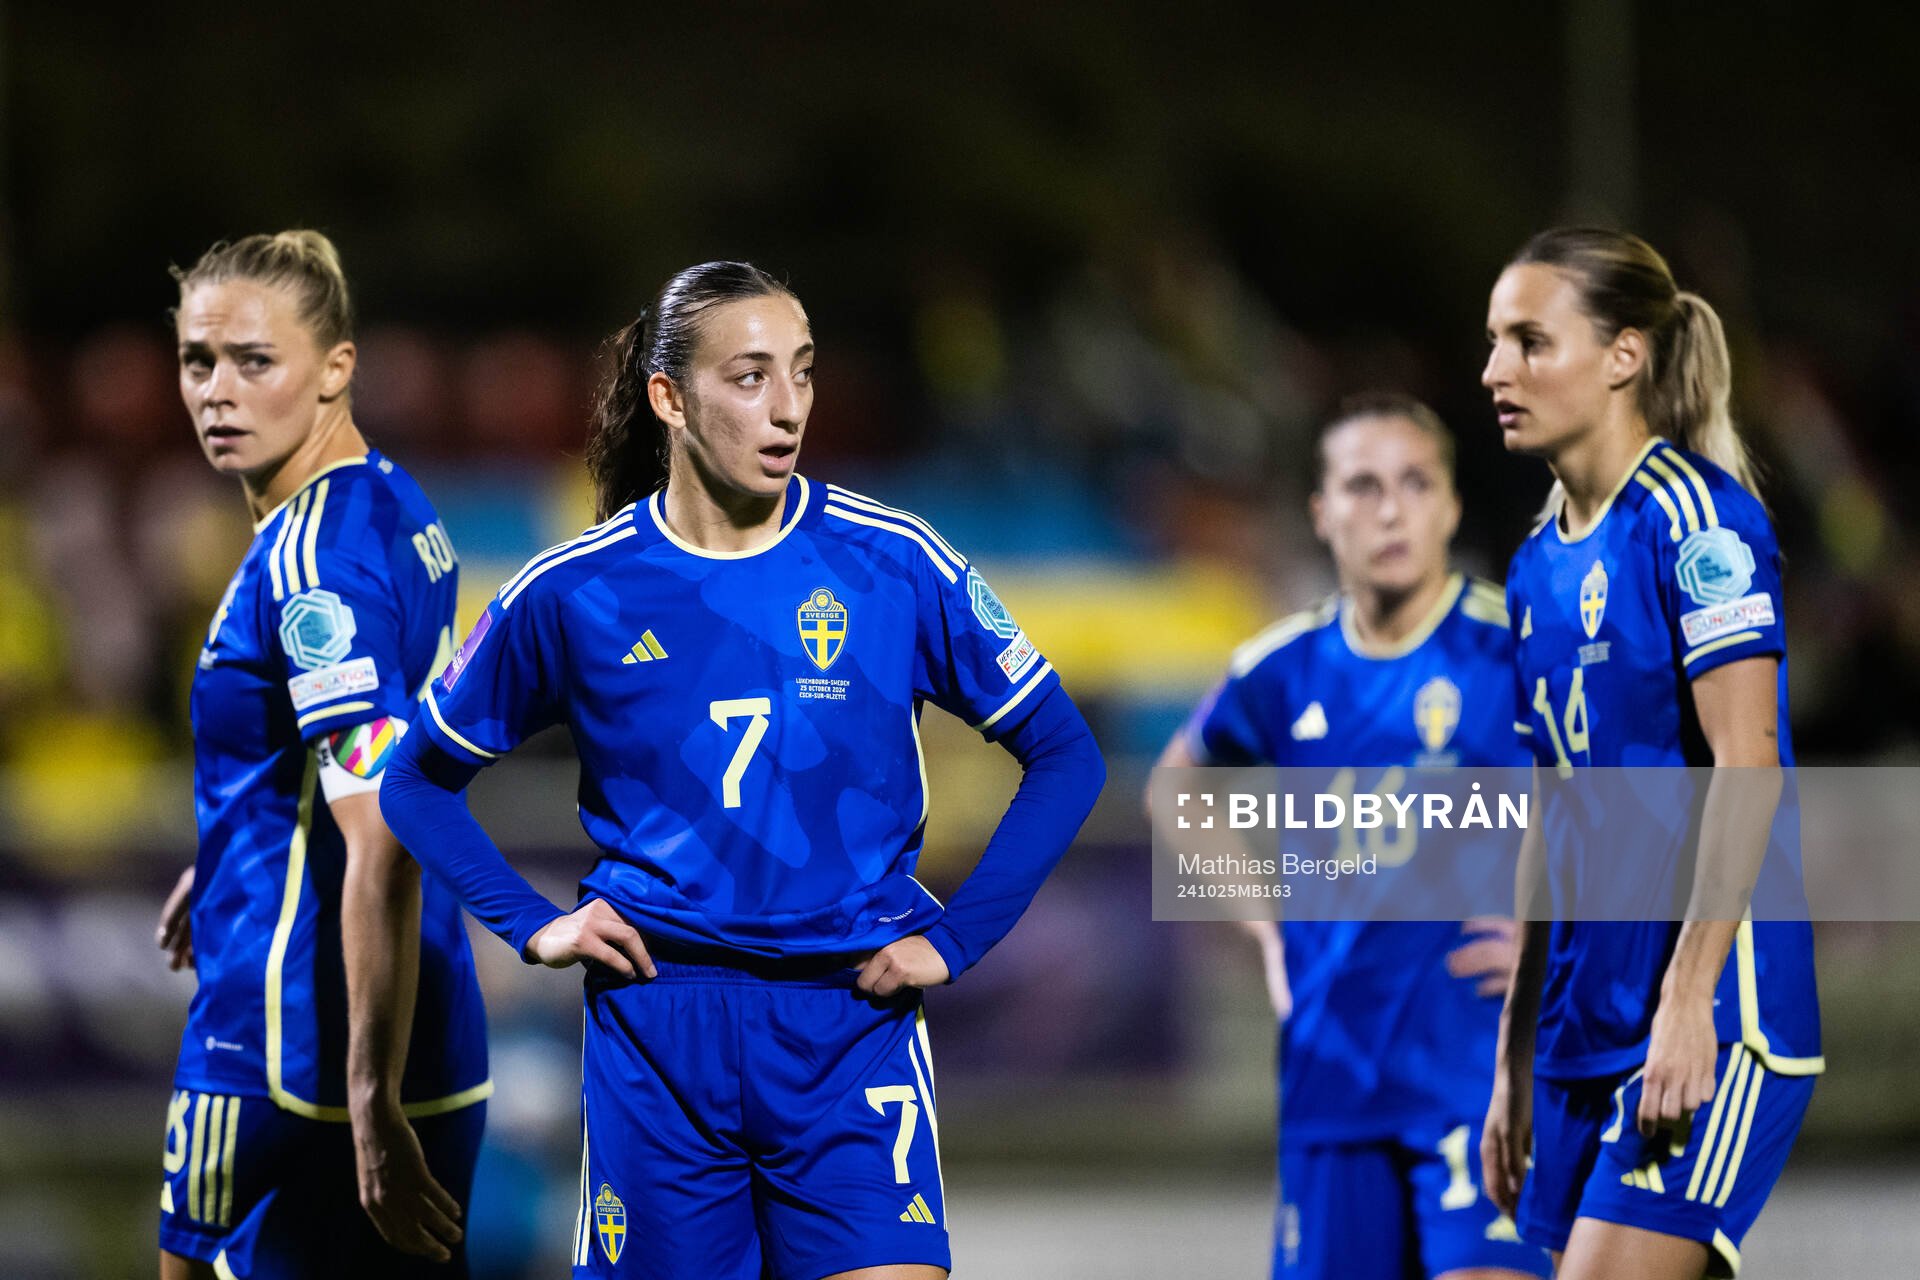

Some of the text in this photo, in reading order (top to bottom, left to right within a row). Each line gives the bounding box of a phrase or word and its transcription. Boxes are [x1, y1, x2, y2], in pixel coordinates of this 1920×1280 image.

[411, 519, 458, 583] RO
[808, 685, 831, 693] OCTOBER
[1533, 667, 1591, 780] 14
[709, 697, 771, 809] 7
[864, 1085, 919, 1184] 7
